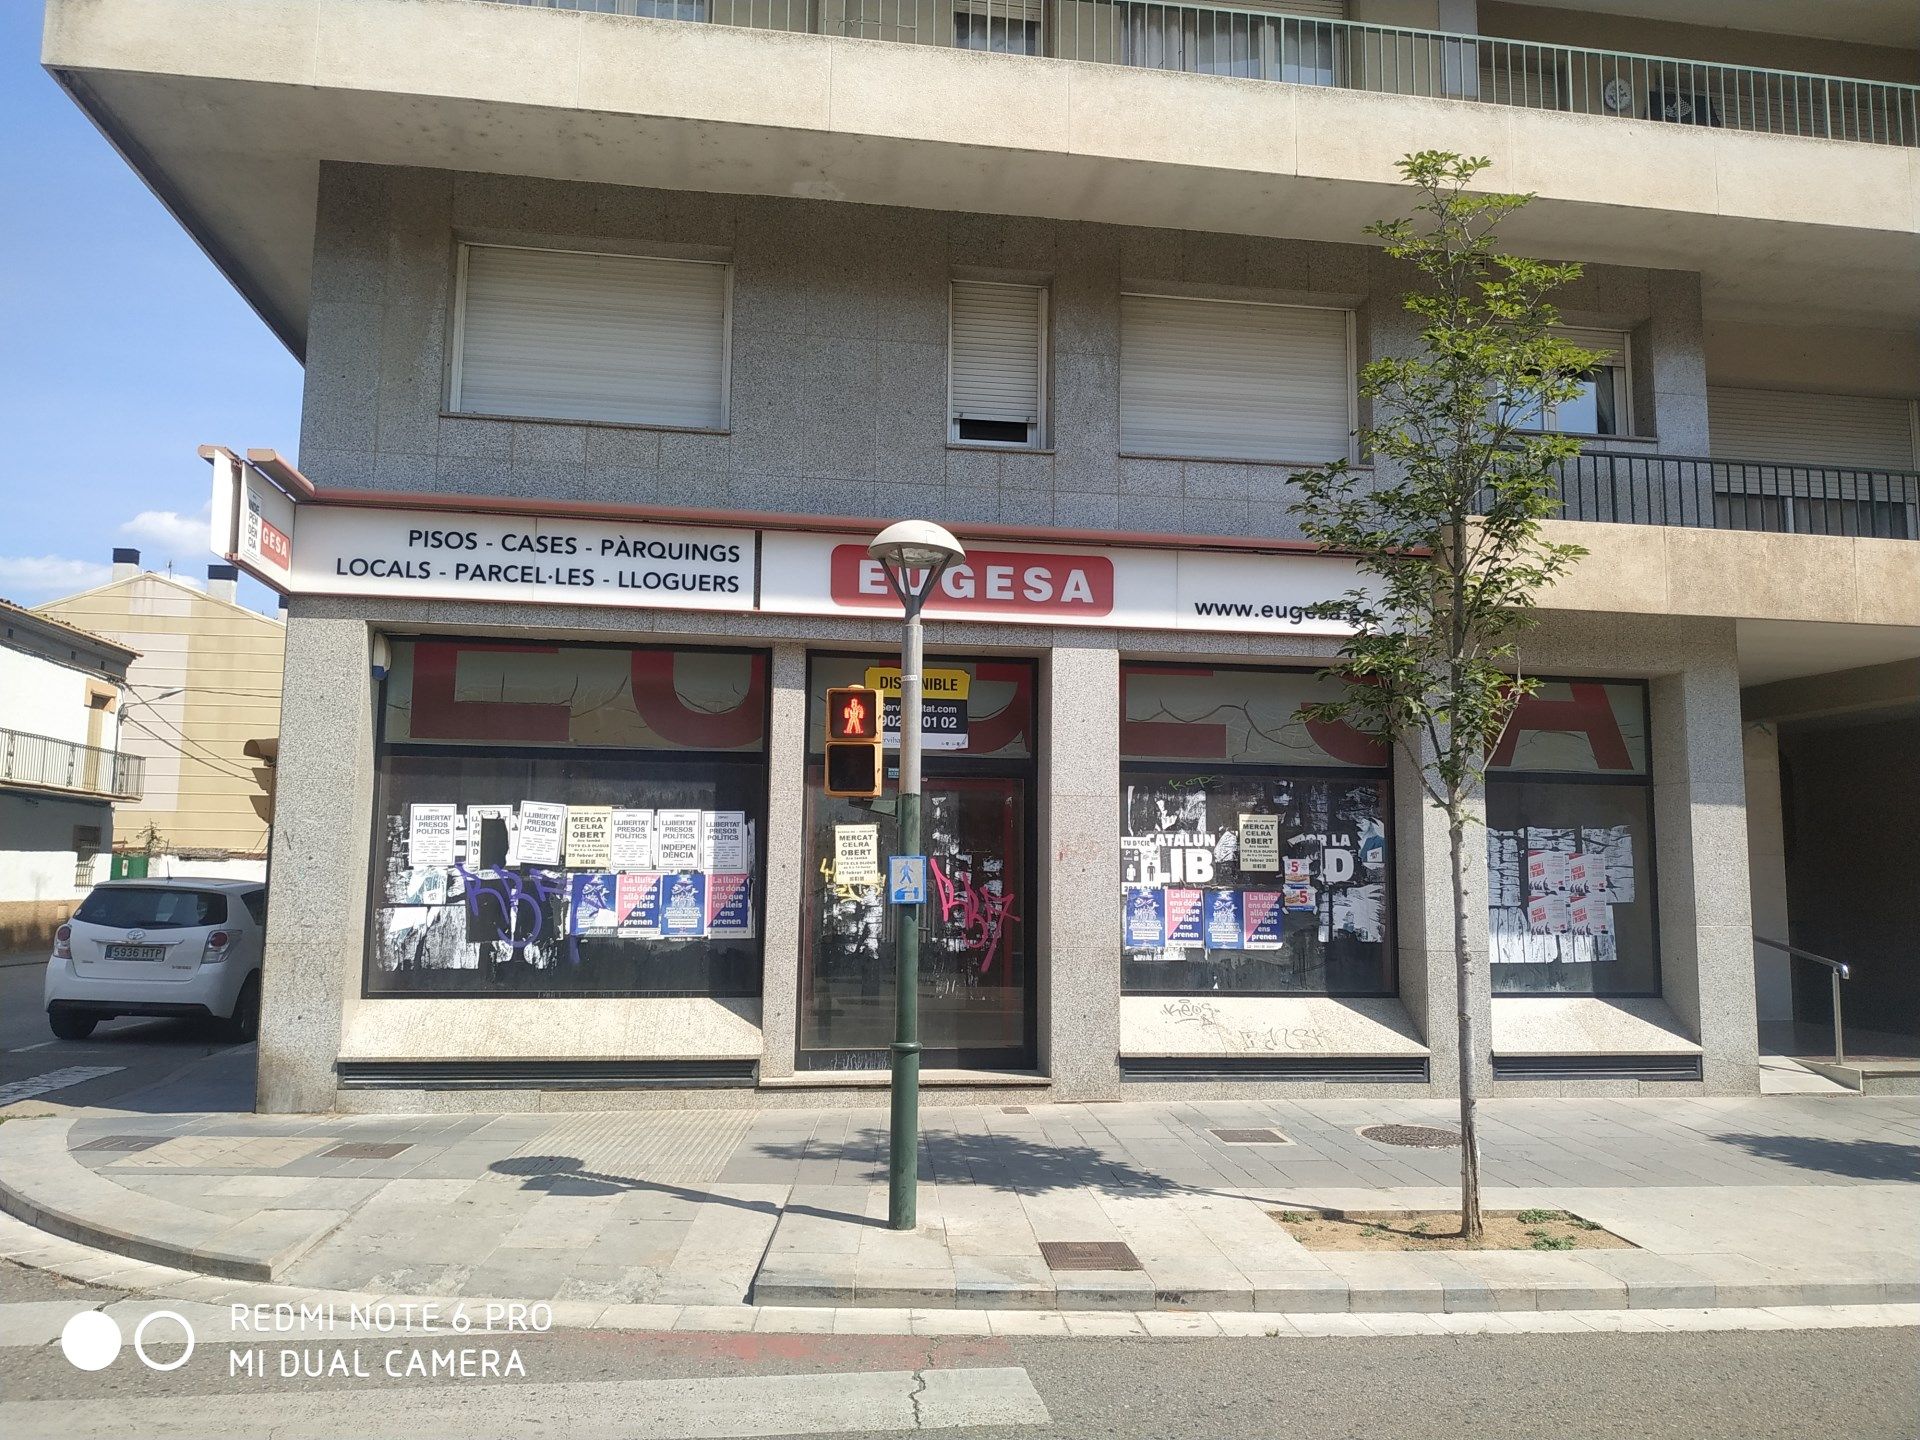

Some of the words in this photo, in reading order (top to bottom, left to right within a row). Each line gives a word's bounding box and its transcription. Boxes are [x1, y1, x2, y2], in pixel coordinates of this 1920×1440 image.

[408, 529, 478, 550] PISOS
[500, 533, 578, 555] CASES
[601, 534, 741, 564] PÀRQUINGS
[336, 558, 431, 580] LOCALS
[454, 563, 595, 587] PARCEL·LES
[617, 570, 740, 594] LLOGUERS
[858, 559, 1094, 604] EUGESA
[880, 676, 958, 692] DISNIBLE
[524, 812, 560, 820] LLIBERTAT
[526, 819, 556, 827] PRESOS
[1332, 834, 1351, 846] LA
[623, 876, 633, 884] La
[634, 876, 656, 884] lluita
[712, 876, 721, 884] La
[723, 876, 744, 884] lluita
[639, 894, 655, 902] que
[728, 894, 743, 902] que
[1248, 893, 1258, 901] La
[1300, 891, 1308, 903] 5
[623, 919, 653, 927] prenen
[712, 918, 742, 926] prenen
[114, 947, 139, 957] 5936
[142, 948, 162, 957] HTP
